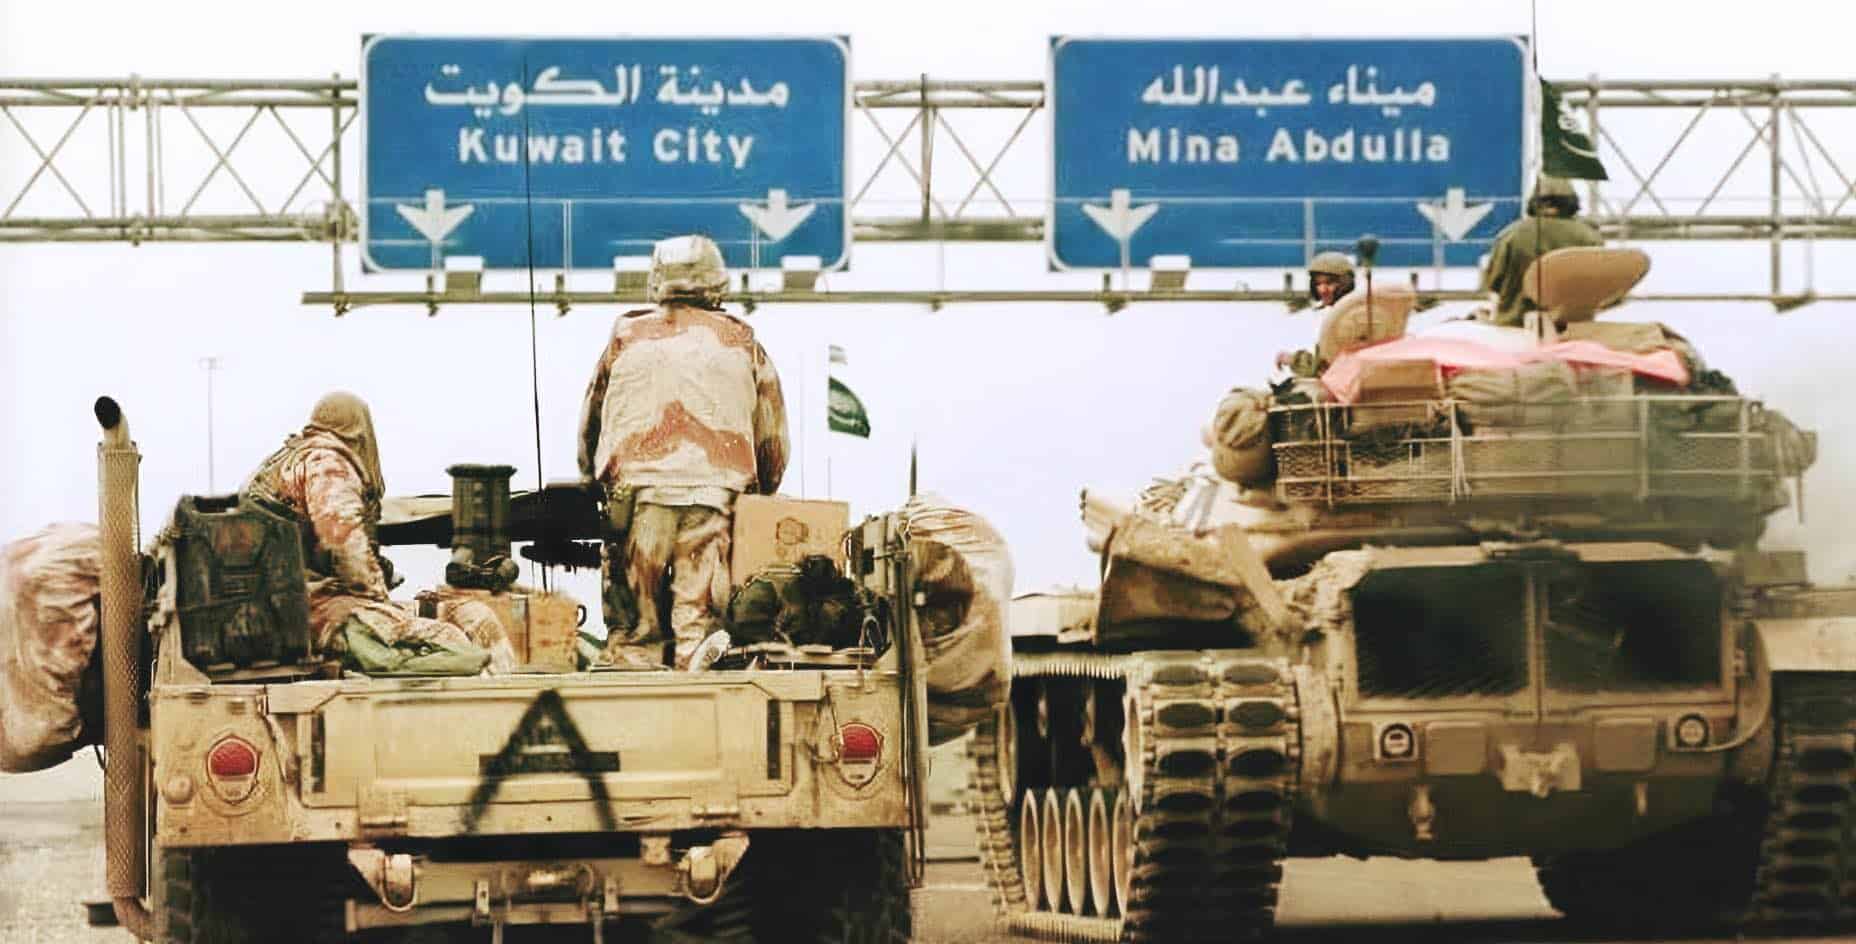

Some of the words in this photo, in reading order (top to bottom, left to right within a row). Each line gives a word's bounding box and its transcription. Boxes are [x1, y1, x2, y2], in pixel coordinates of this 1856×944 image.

[424, 64, 641, 116] الكويت
[656, 65, 790, 115] مدينة
[1141, 65, 1312, 117] عبدالله
[1328, 65, 1437, 116] ميناء
[458, 127, 626, 164] Kuwait
[652, 127, 755, 169] City
[1127, 127, 1239, 164] Mina
[1266, 128, 1450, 163] Abdulla
